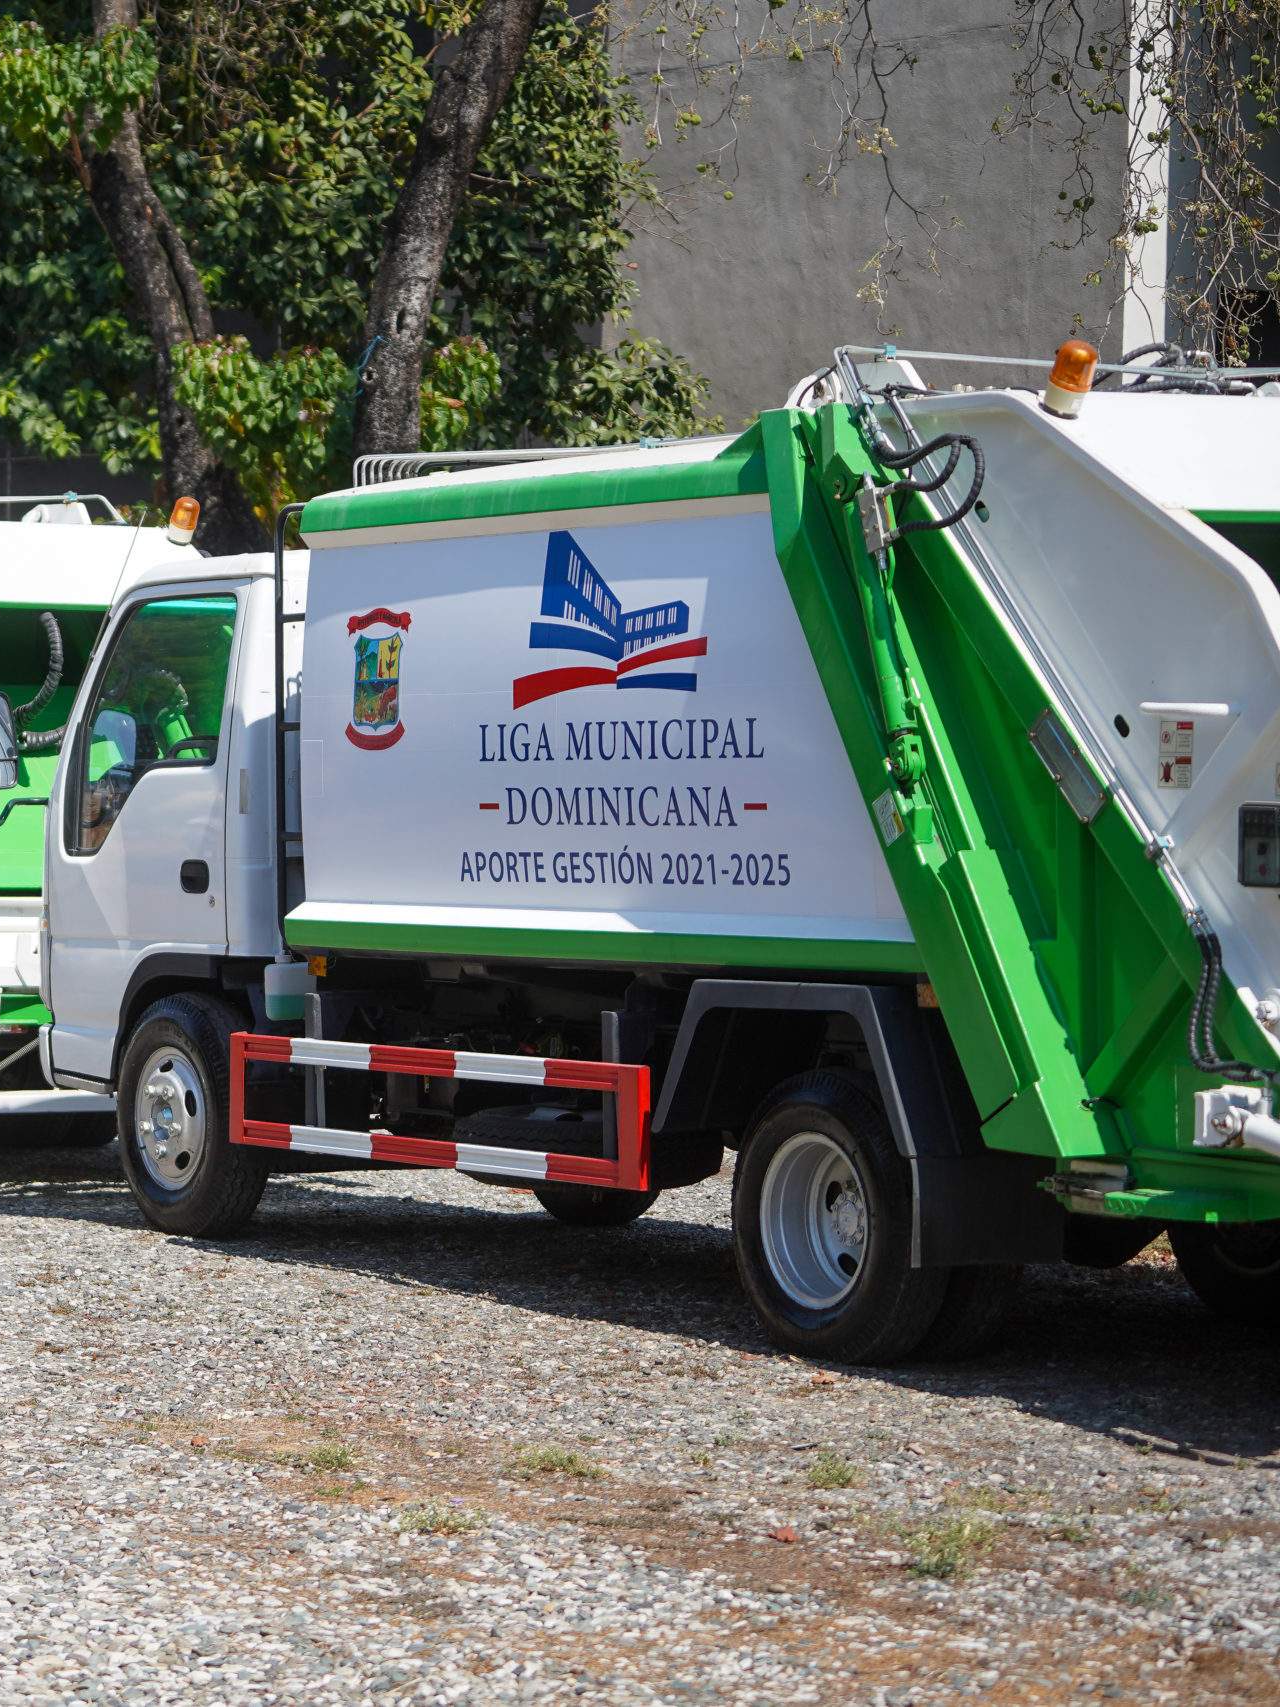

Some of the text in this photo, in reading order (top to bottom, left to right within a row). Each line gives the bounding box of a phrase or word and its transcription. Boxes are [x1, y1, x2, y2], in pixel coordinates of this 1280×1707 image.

[479, 717, 765, 762] LIGA MUNICIPAL
[505, 786, 738, 827] DOMINICANA
[460, 845, 791, 887] APORTE GESTIÓN 2021-2025
